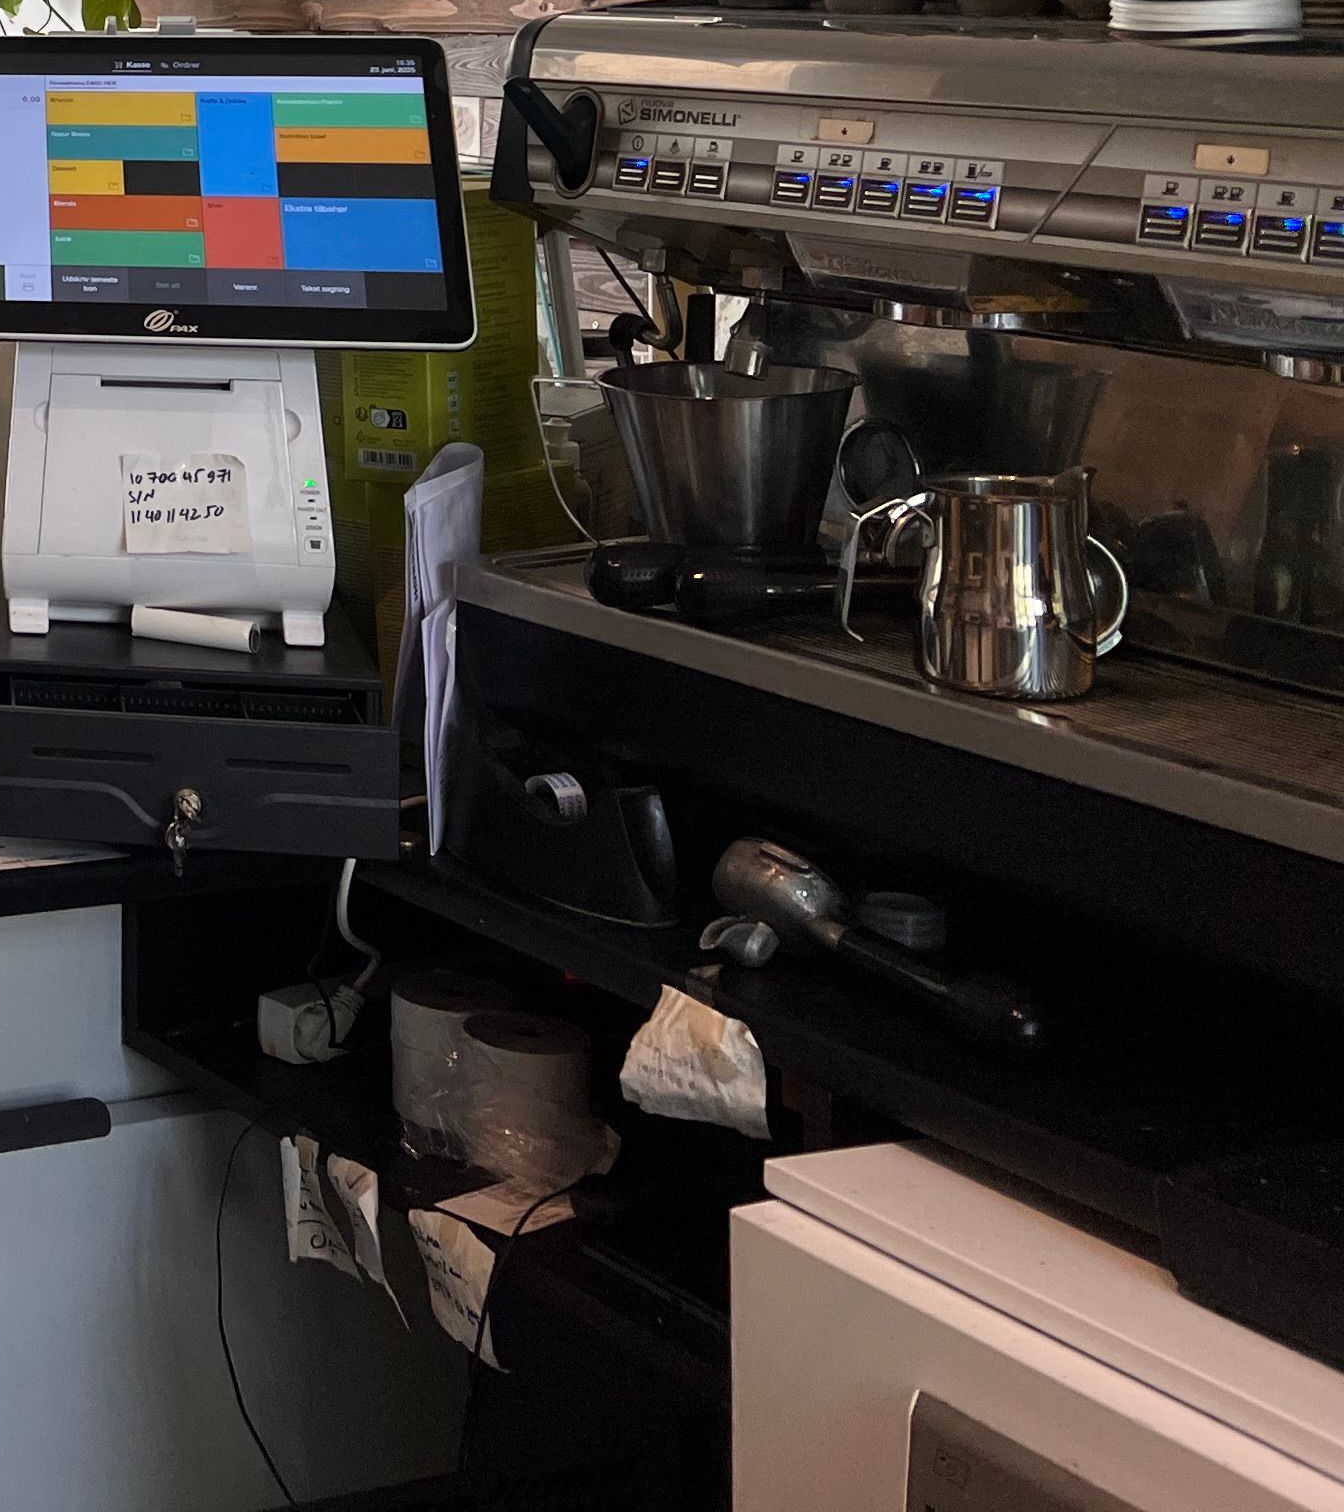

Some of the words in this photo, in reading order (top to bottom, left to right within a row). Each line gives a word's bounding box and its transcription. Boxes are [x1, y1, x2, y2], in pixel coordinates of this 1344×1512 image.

[126, 61, 151, 69] Kasse
[172, 61, 201, 69] Ordrer
[639, 108, 737, 127] SIMONELLI
[169, 324, 200, 333] PAX
[128, 488, 155, 505] S/N
